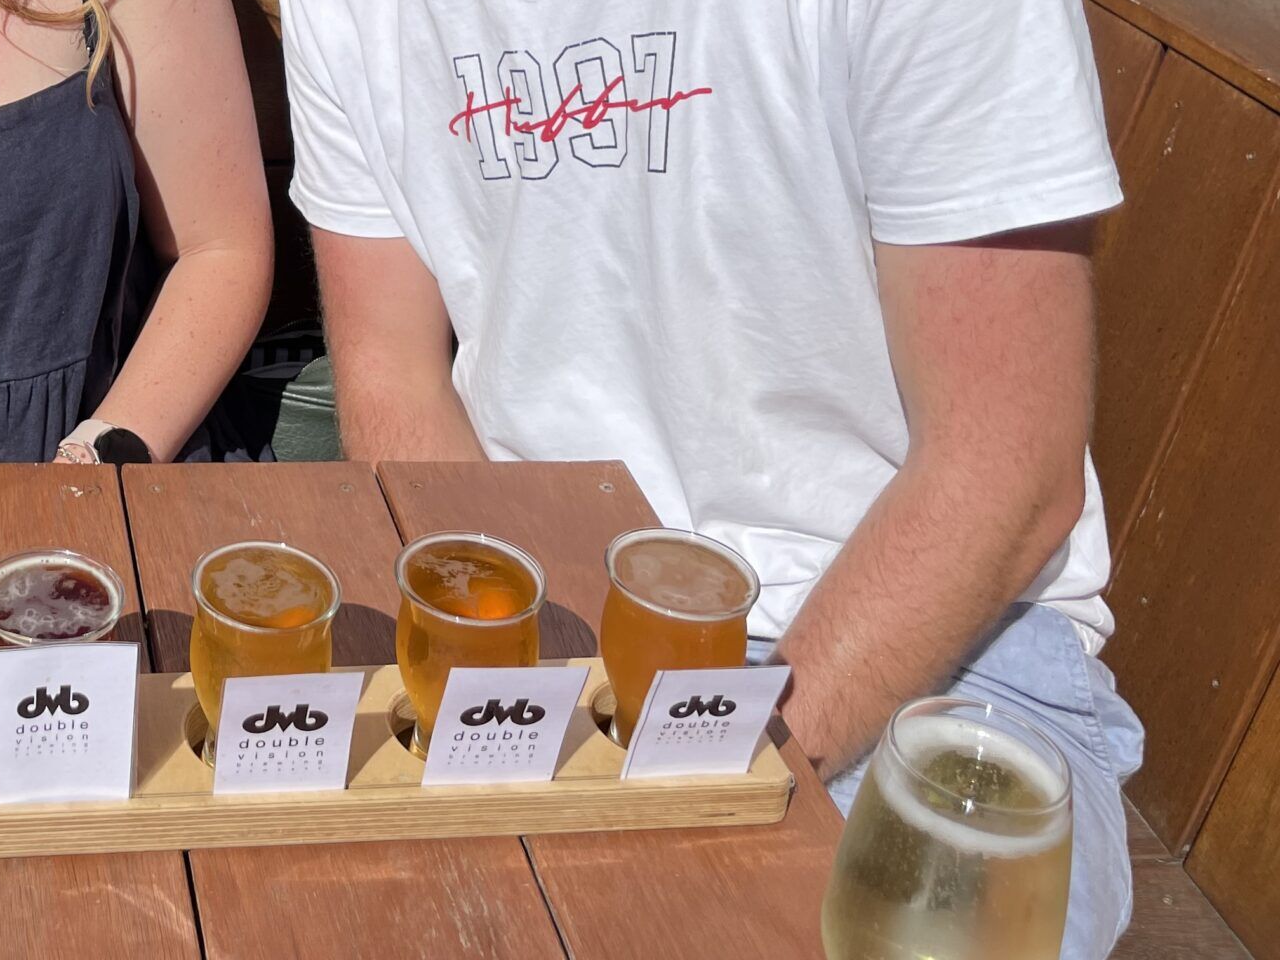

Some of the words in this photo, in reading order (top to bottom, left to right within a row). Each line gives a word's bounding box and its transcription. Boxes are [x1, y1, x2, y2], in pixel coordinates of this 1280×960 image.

[453, 31, 676, 180] 1997
[16, 719, 89, 735] double
[662, 720, 730, 729] double
[16, 733, 88, 745] vision
[453, 729, 538, 742] double
[239, 736, 325, 749] double
[451, 743, 536, 752] vision
[238, 750, 323, 760] vision
